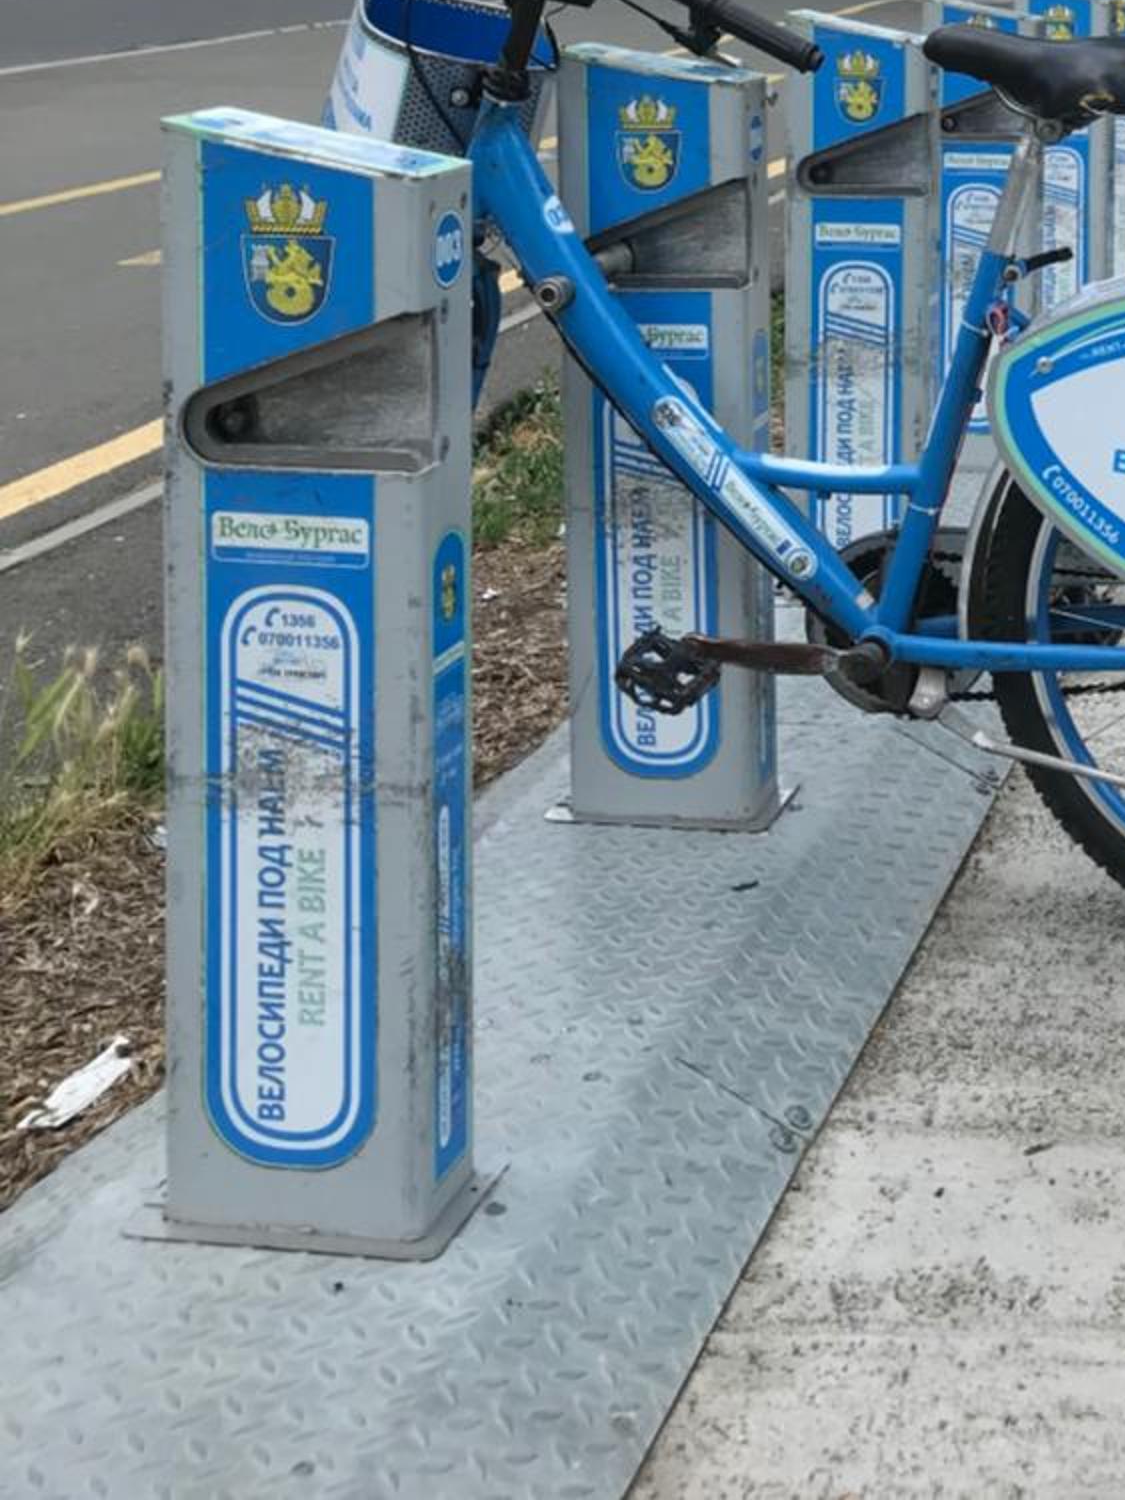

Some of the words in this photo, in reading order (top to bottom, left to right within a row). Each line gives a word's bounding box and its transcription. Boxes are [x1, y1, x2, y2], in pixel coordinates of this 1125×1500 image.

[1051, 476, 1120, 544] 070011356
[631, 553, 657, 598] ПОД
[257, 844, 293, 909] ПОД
[297, 848, 326, 914] BIKE
[298, 922, 326, 944] A
[257, 918, 292, 1121] ВЕЛОСИПЕДИ
[297, 949, 326, 1026] RENT
